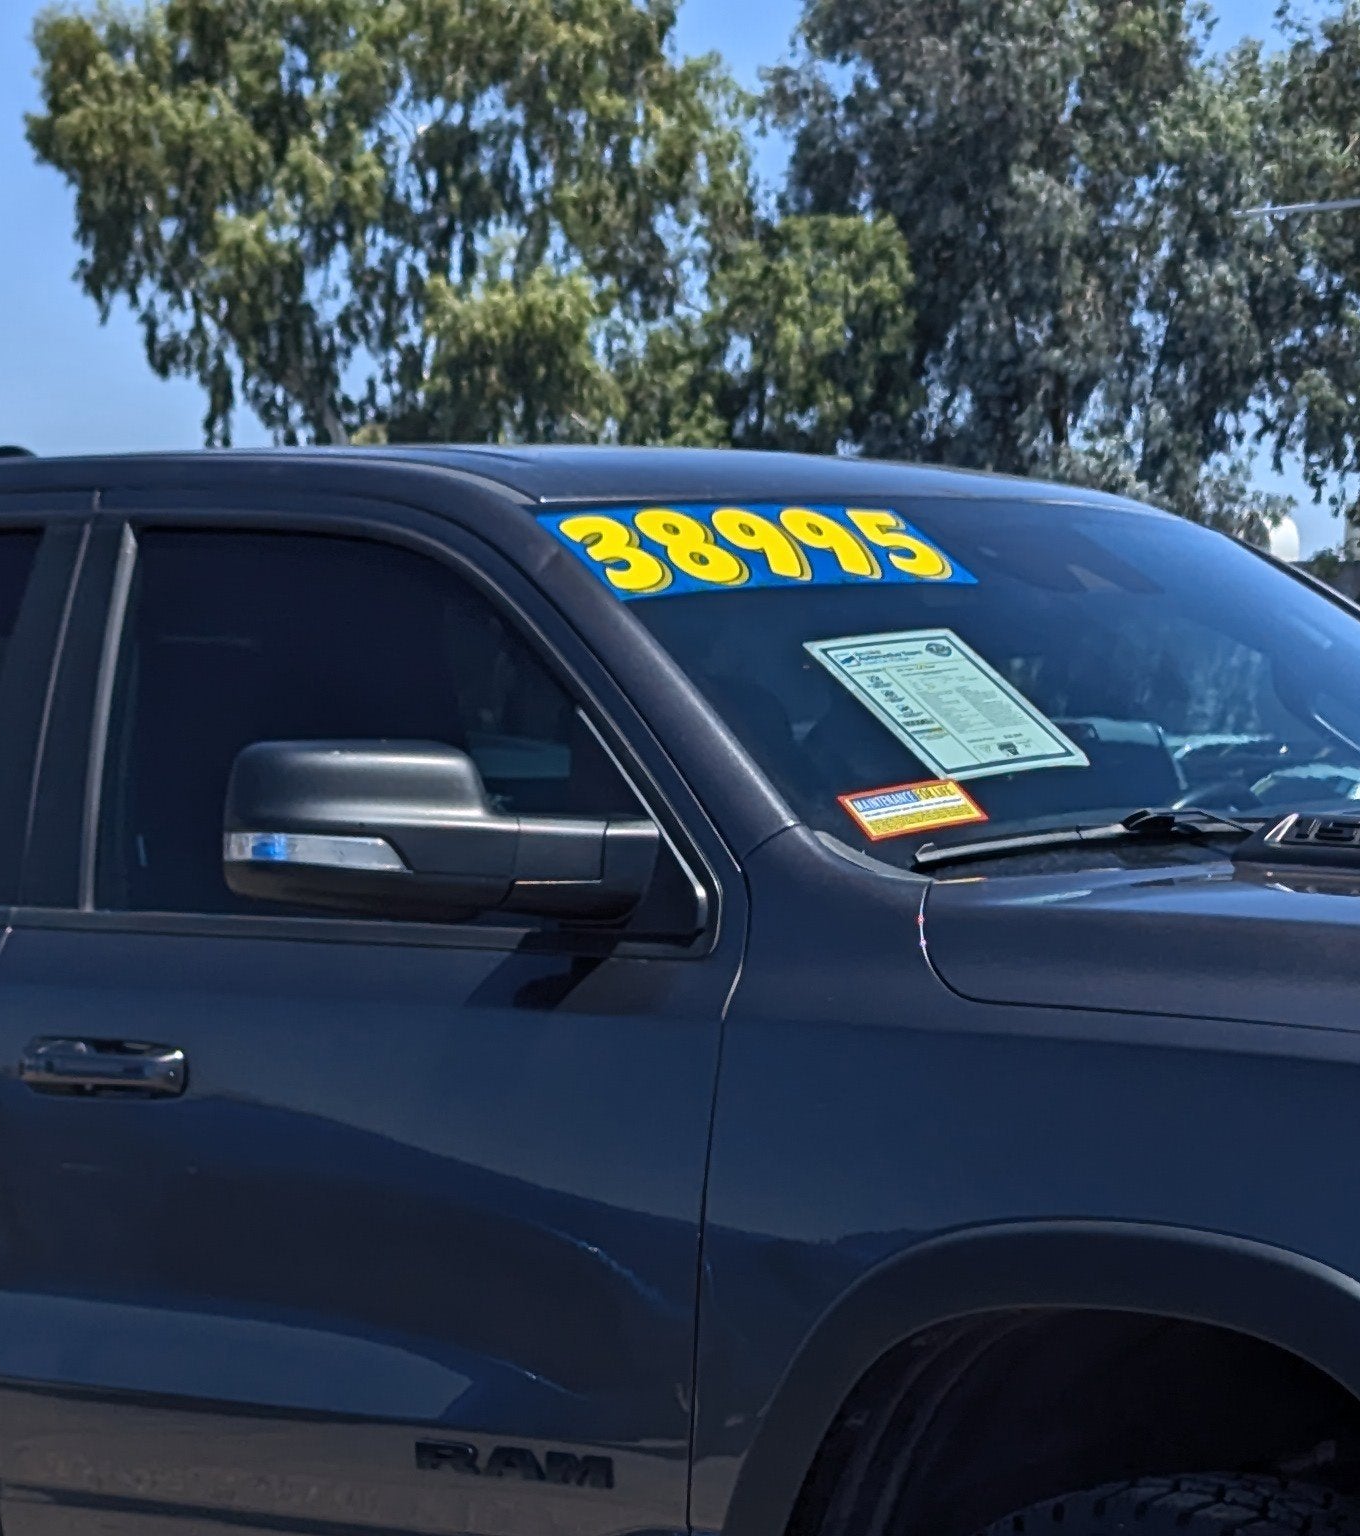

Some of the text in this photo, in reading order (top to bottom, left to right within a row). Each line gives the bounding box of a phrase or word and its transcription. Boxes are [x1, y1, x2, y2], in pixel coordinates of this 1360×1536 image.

[559, 508, 952, 593] 38995
[853, 790, 919, 812] MAINTENANCE
[415, 1441, 614, 1490] RAM
